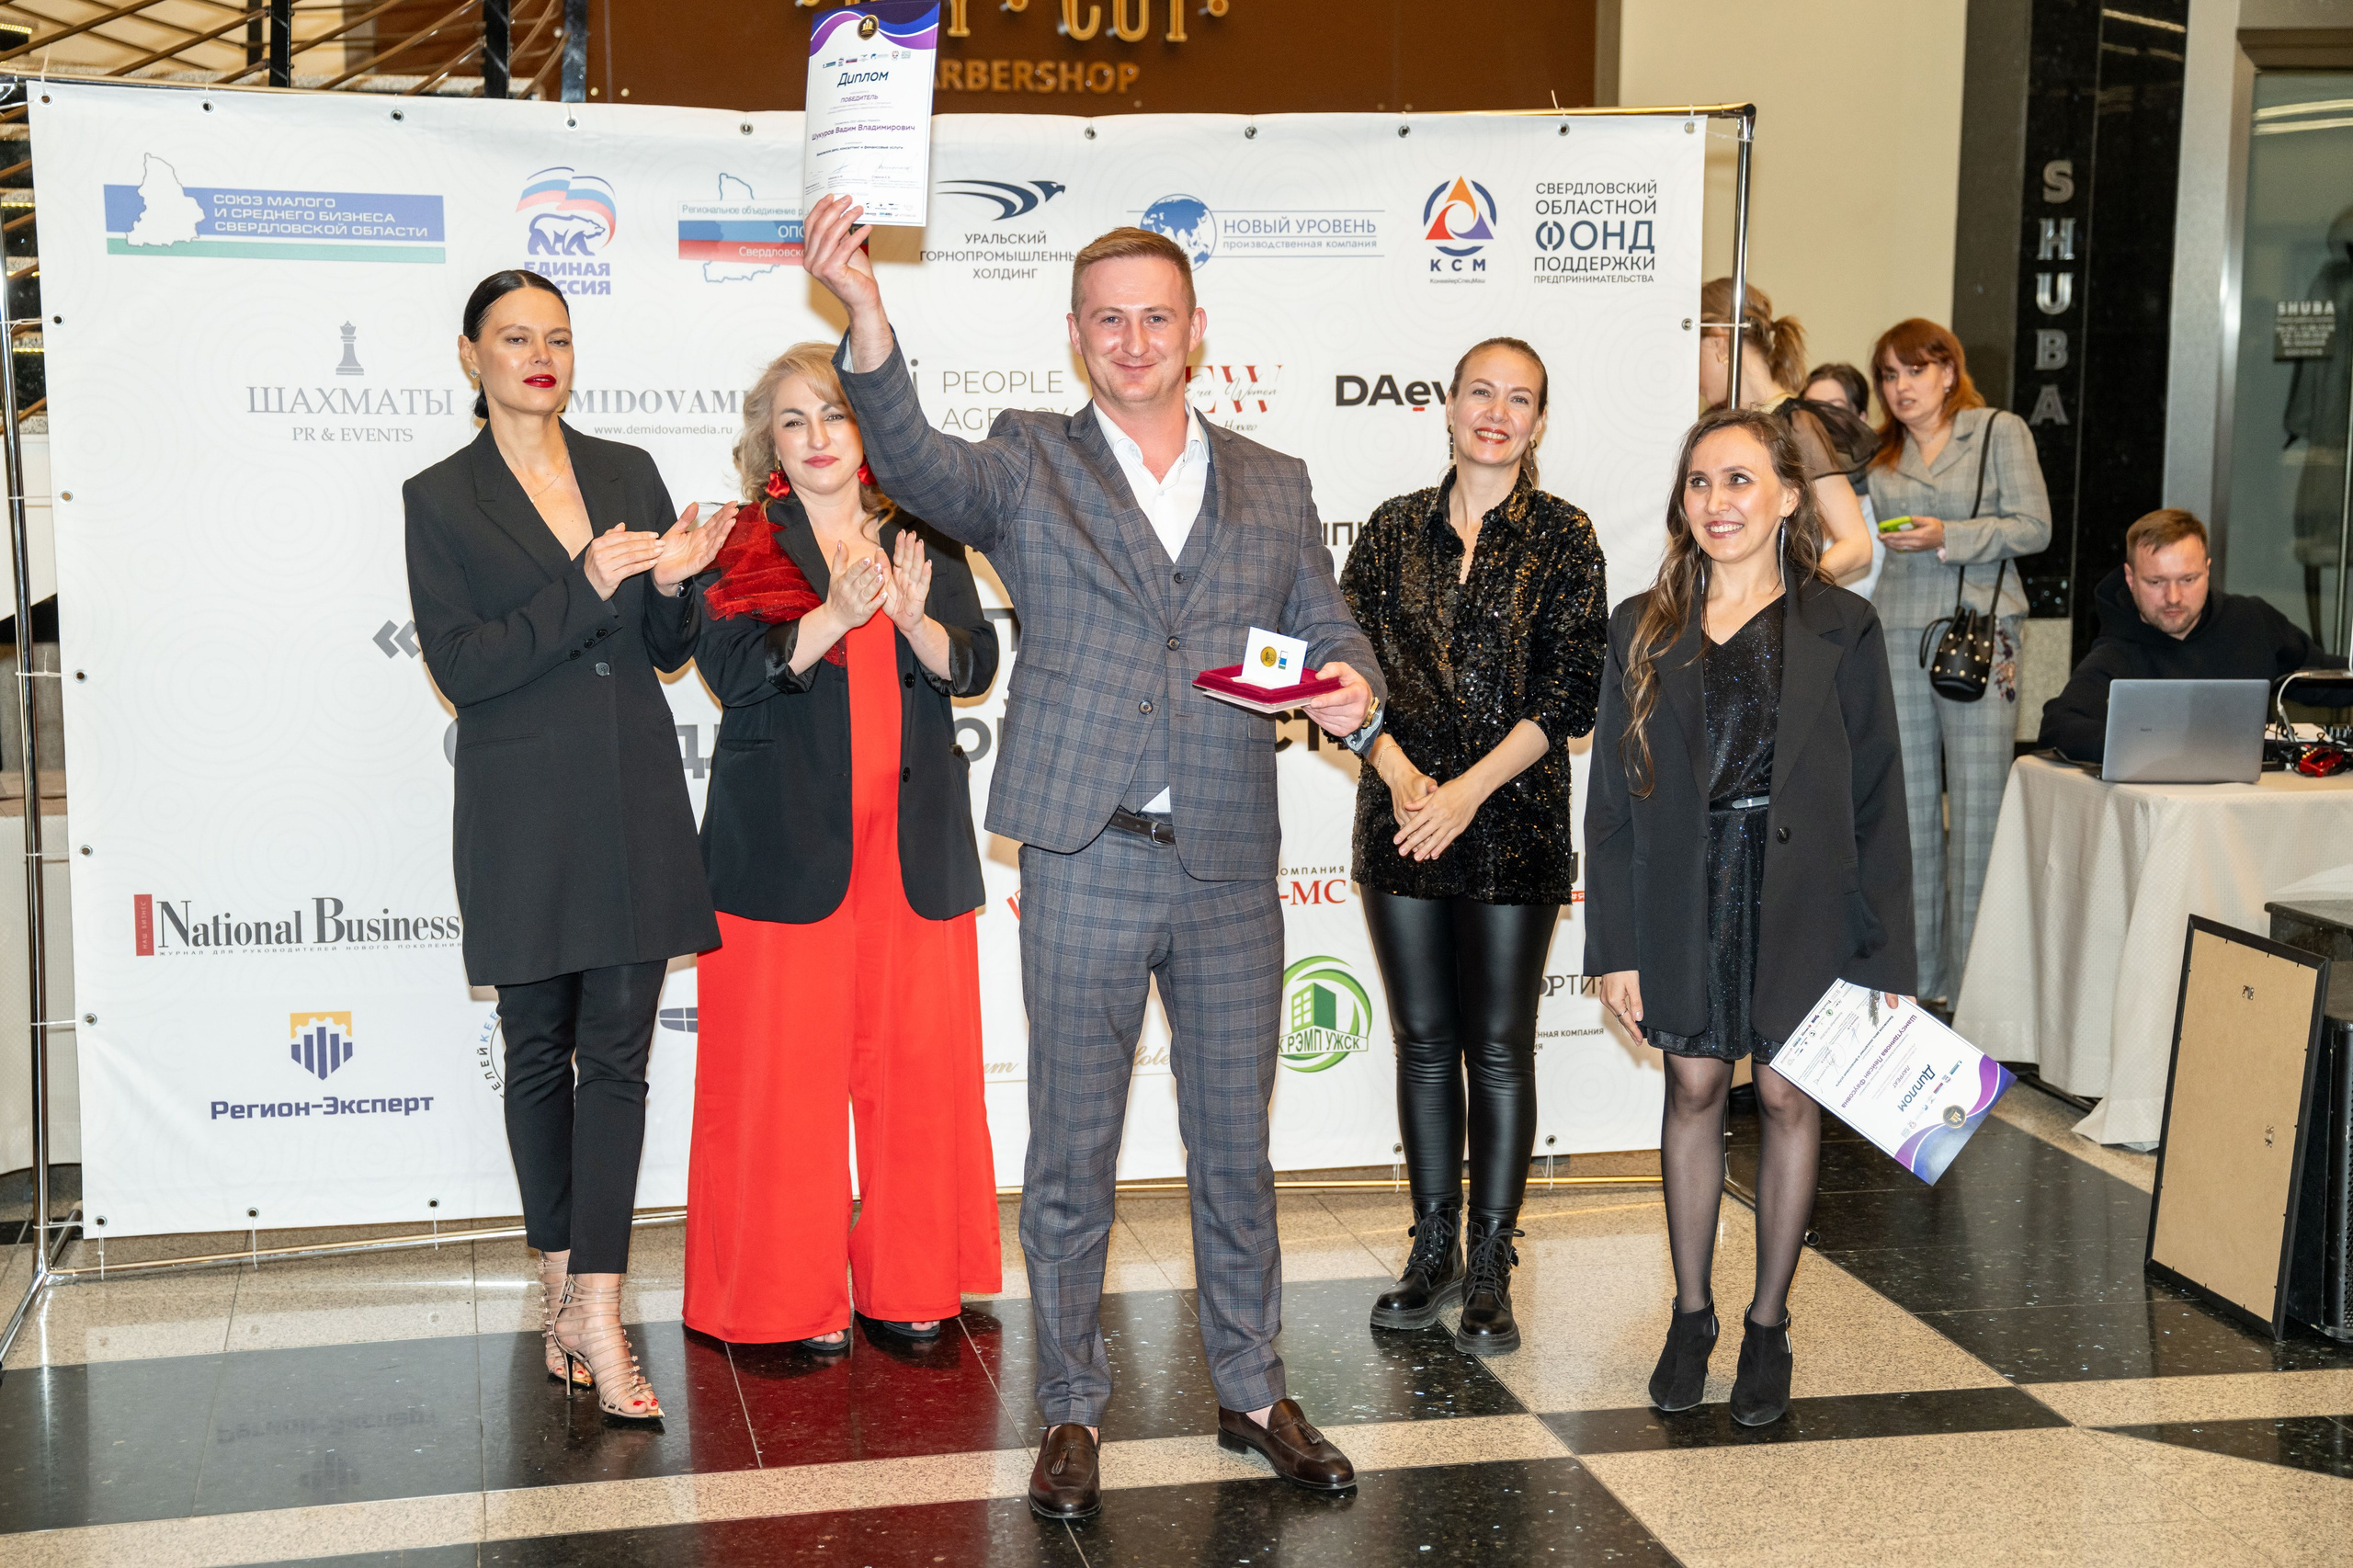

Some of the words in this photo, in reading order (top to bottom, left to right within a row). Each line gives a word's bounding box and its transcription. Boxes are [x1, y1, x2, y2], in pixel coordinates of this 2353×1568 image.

[837, 71, 889, 87] Диплом
[840, 94, 879, 103] ПОБЕДИТЕЛЬ
[835, 125, 856, 134] Вадим
[1536, 179, 1657, 195] СВЕРДЛОВСКИЙ
[213, 194, 263, 206] СОЮЗ
[267, 196, 335, 208] МАЛОГО
[1536, 196, 1656, 215] ОБЛАСТНОЙ
[214, 208, 227, 218] И
[231, 210, 315, 222] СРЕДНЕГО
[319, 211, 395, 222] БИЗНЕСА
[682, 205, 740, 215] Региональное
[742, 205, 796, 216] объединение
[214, 222, 347, 235] СВЕРДЛОВСКОЙ
[351, 225, 428, 237] ОБЛАСТИ
[1223, 217, 1290, 233] НОВЫЙ
[1296, 219, 1376, 233] УРОВЕНЬ
[965, 231, 1046, 244] УРАЛЬСКИЙ
[1223, 241, 1322, 250] производственная
[1535, 220, 1654, 255] ФОНД
[739, 246, 804, 258] Свердловско
[920, 250, 1075, 262] ГОРНОПРОМЫШЛЕННЫ
[524, 261, 610, 277] ЕДИНАЯ
[1534, 256, 1655, 273] ПОДДЕРЖКИ
[972, 268, 1038, 280] ХОЛДИНГ
[1534, 275, 1654, 284] ПРЕДПРИНИМАТЕЛЬСТВА
[554, 279, 611, 295] ССИЯ
[2029, 159, 2075, 426] SHUBA
[943, 370, 1063, 393] PEOPLE
[245, 386, 455, 415] ШАХМАТЫ
[565, 390, 748, 414] MIDOVAM
[941, 407, 1069, 430] AGE
[291, 426, 316, 441] PR
[321, 427, 335, 441] &
[340, 426, 414, 442] EVENTS
[594, 424, 733, 435] www.demidovamedia.ru
[1279, 866, 1345, 876] ОМПАНИЯ
[156, 900, 304, 948] National
[312, 896, 460, 944] Business
[243, 946, 337, 954] РУКОВОДИТЕЛЕЙ
[1288, 1028, 1322, 1052] РЭМП
[1325, 1030, 1360, 1051] УЖСК
[1561, 1028, 1604, 1037] КОМПАНИЯ
[1892, 1065, 1910, 1088] ЛАУРЕАТ
[1897, 1064, 1936, 1112] Диплом
[210, 1096, 434, 1119] Регион-Эксперт
